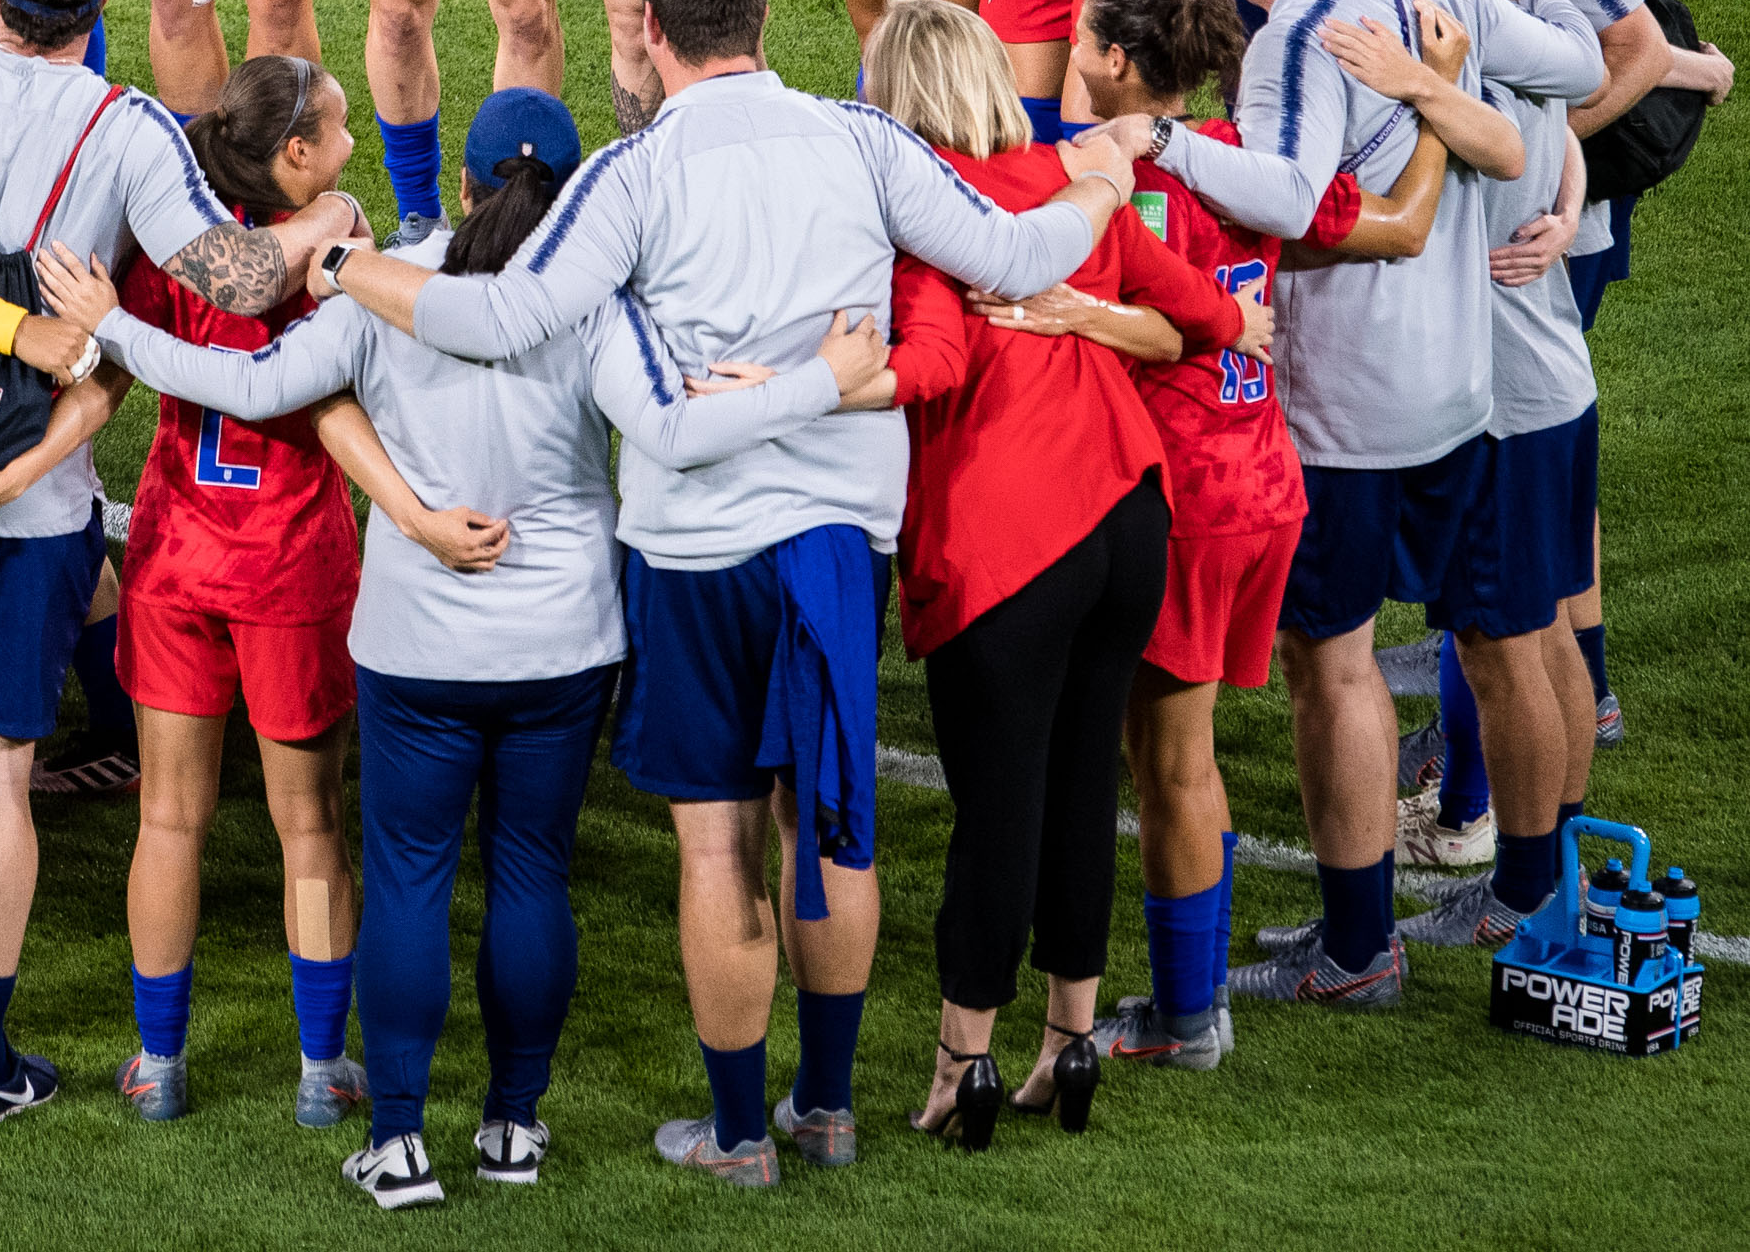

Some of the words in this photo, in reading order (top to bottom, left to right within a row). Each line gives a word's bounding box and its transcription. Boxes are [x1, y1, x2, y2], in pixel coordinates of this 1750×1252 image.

[1502, 967, 1630, 1018] POWER
[1513, 1020, 1557, 1038] OFFICIAL
[1559, 1029, 1597, 1047] SPORTS
[1598, 1039, 1628, 1053] DRINK
[1552, 1003, 1626, 1042] ADE
